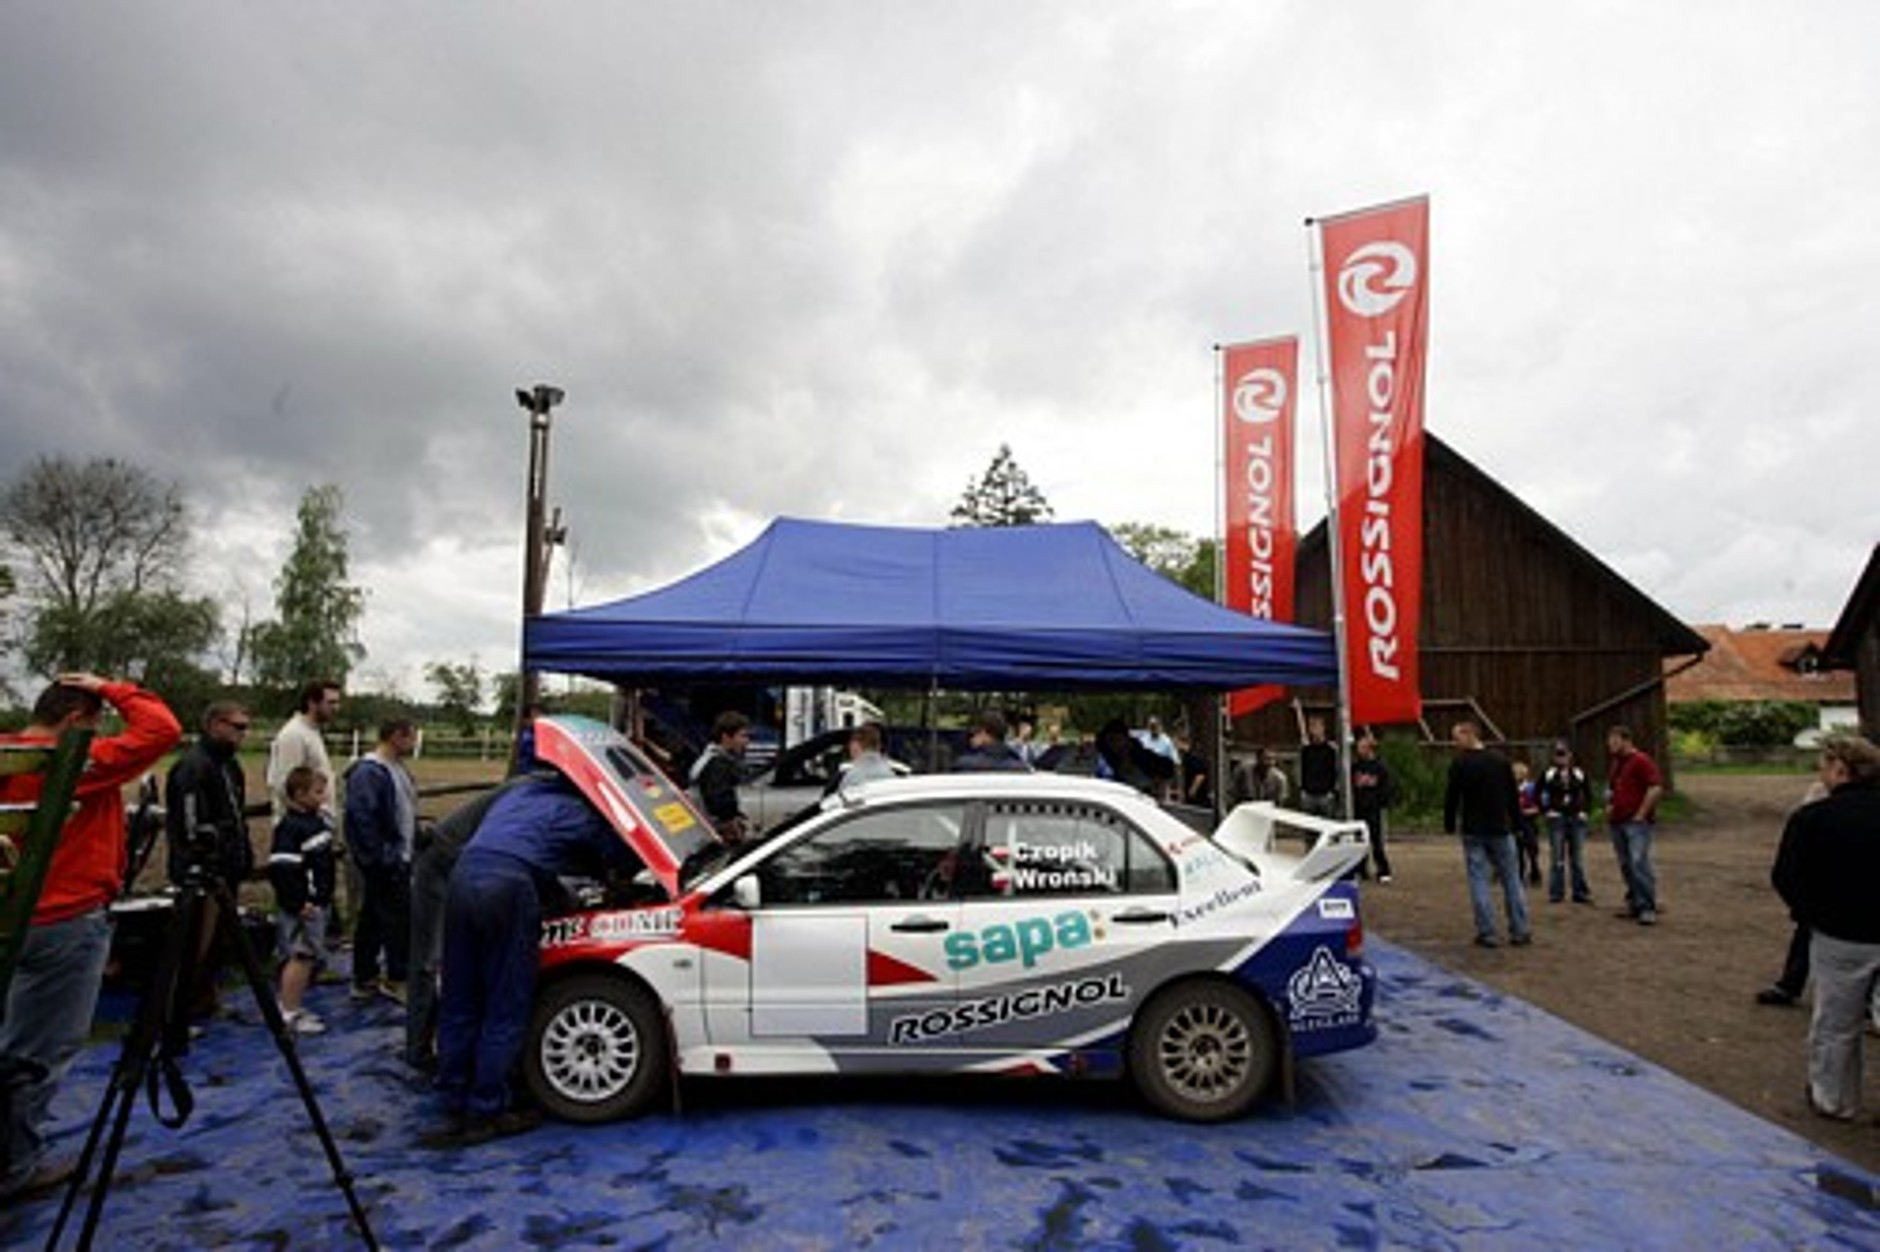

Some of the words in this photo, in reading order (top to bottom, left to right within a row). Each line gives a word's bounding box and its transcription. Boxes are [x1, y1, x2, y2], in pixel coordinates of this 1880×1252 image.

[1248, 434, 1273, 621] SSIGNOL
[1361, 331, 1399, 679] ROSSIGNOL
[889, 976, 1128, 1044] ROSSIGNOL
